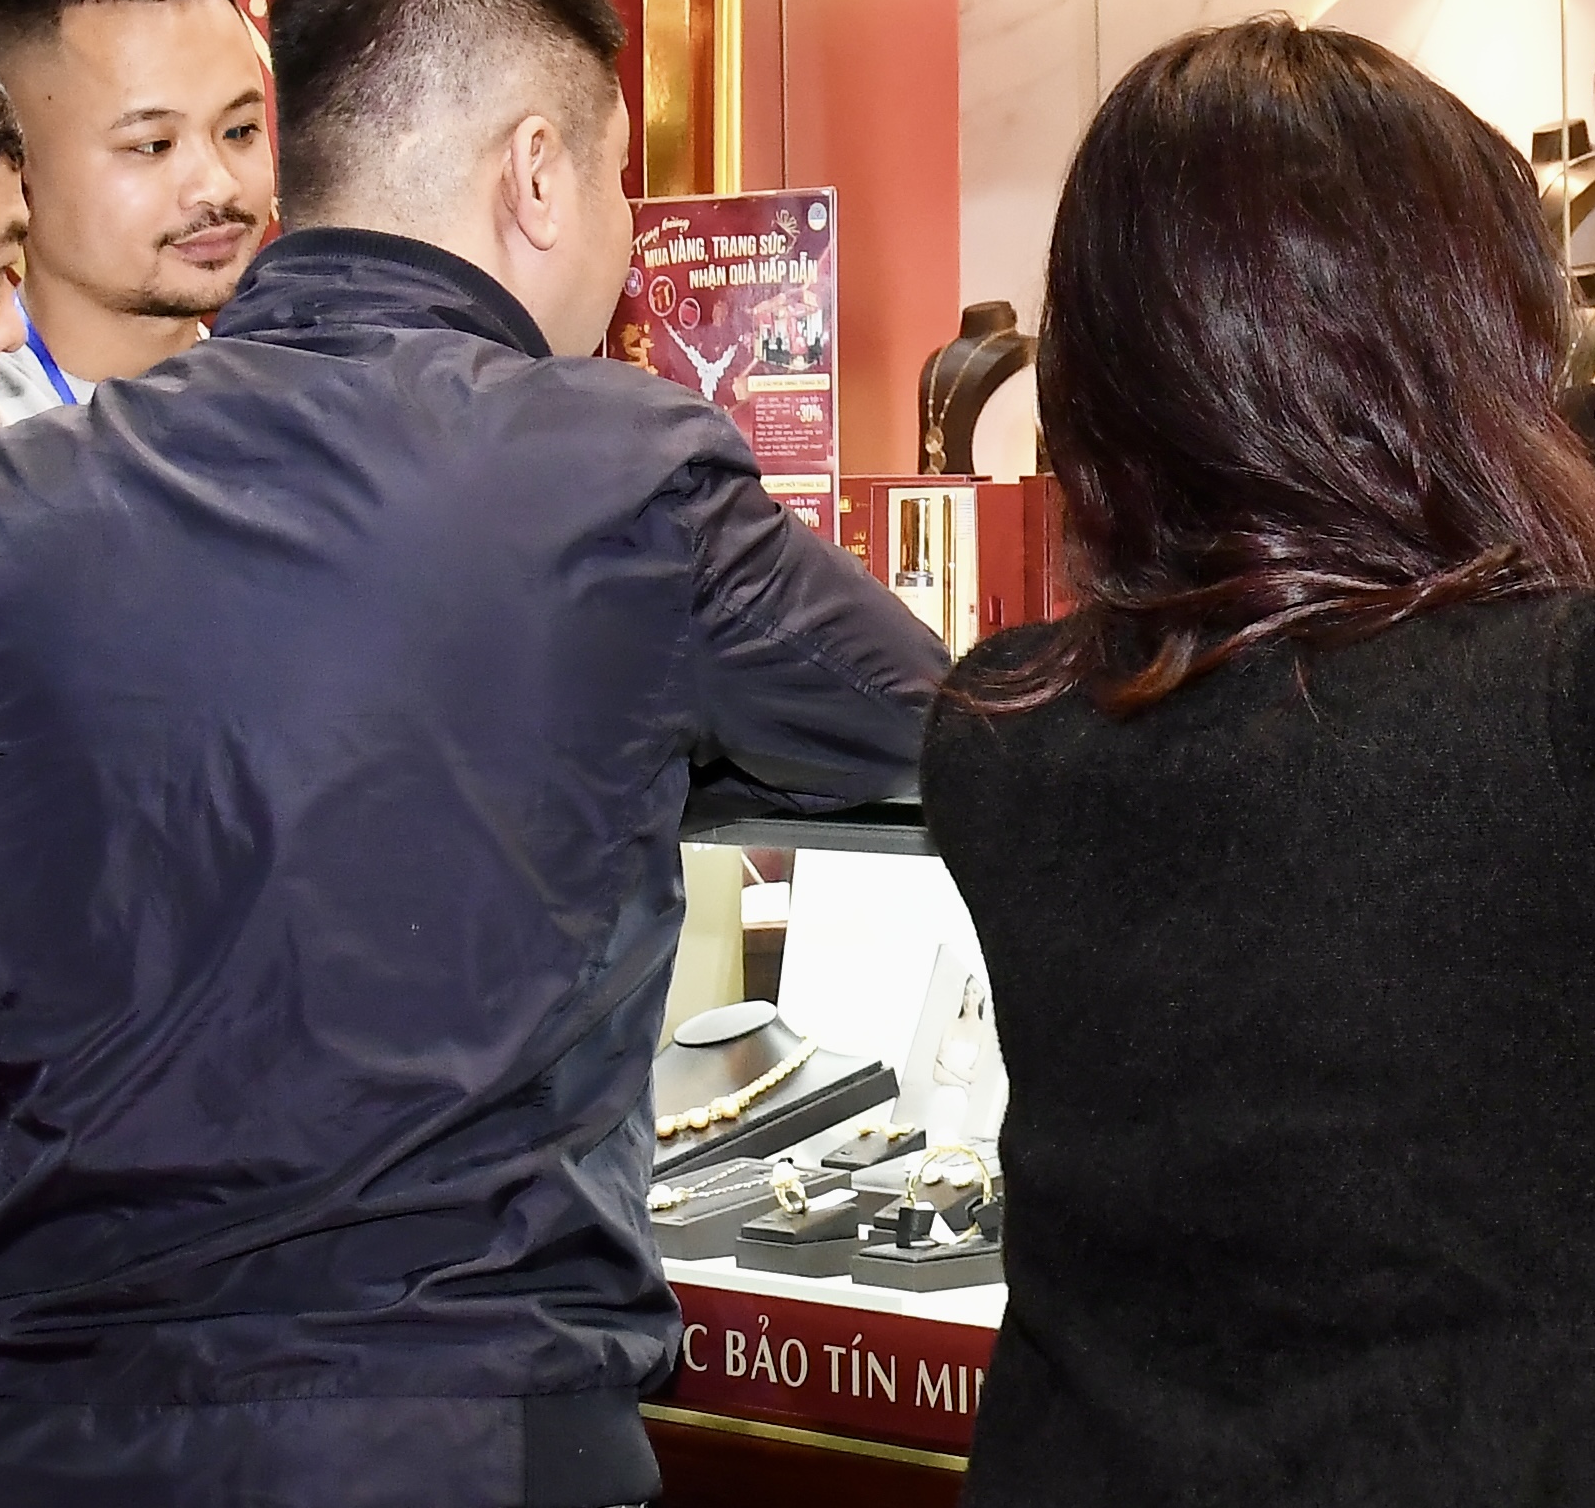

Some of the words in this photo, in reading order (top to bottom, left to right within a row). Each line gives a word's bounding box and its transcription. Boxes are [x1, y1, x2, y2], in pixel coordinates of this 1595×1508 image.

[643, 246, 669, 269] MUA
[667, 233, 710, 264] VÀNG,
[711, 235, 757, 259] TRANG
[758, 230, 787, 255] SỨC
[688, 264, 727, 291] NHẬN
[728, 257, 756, 286] QUÀ
[758, 253, 788, 284] HẤP
[788, 250, 819, 285] DẪN
[725, 1313, 809, 1388] BẢO
[823, 1332, 896, 1403] TÍN
